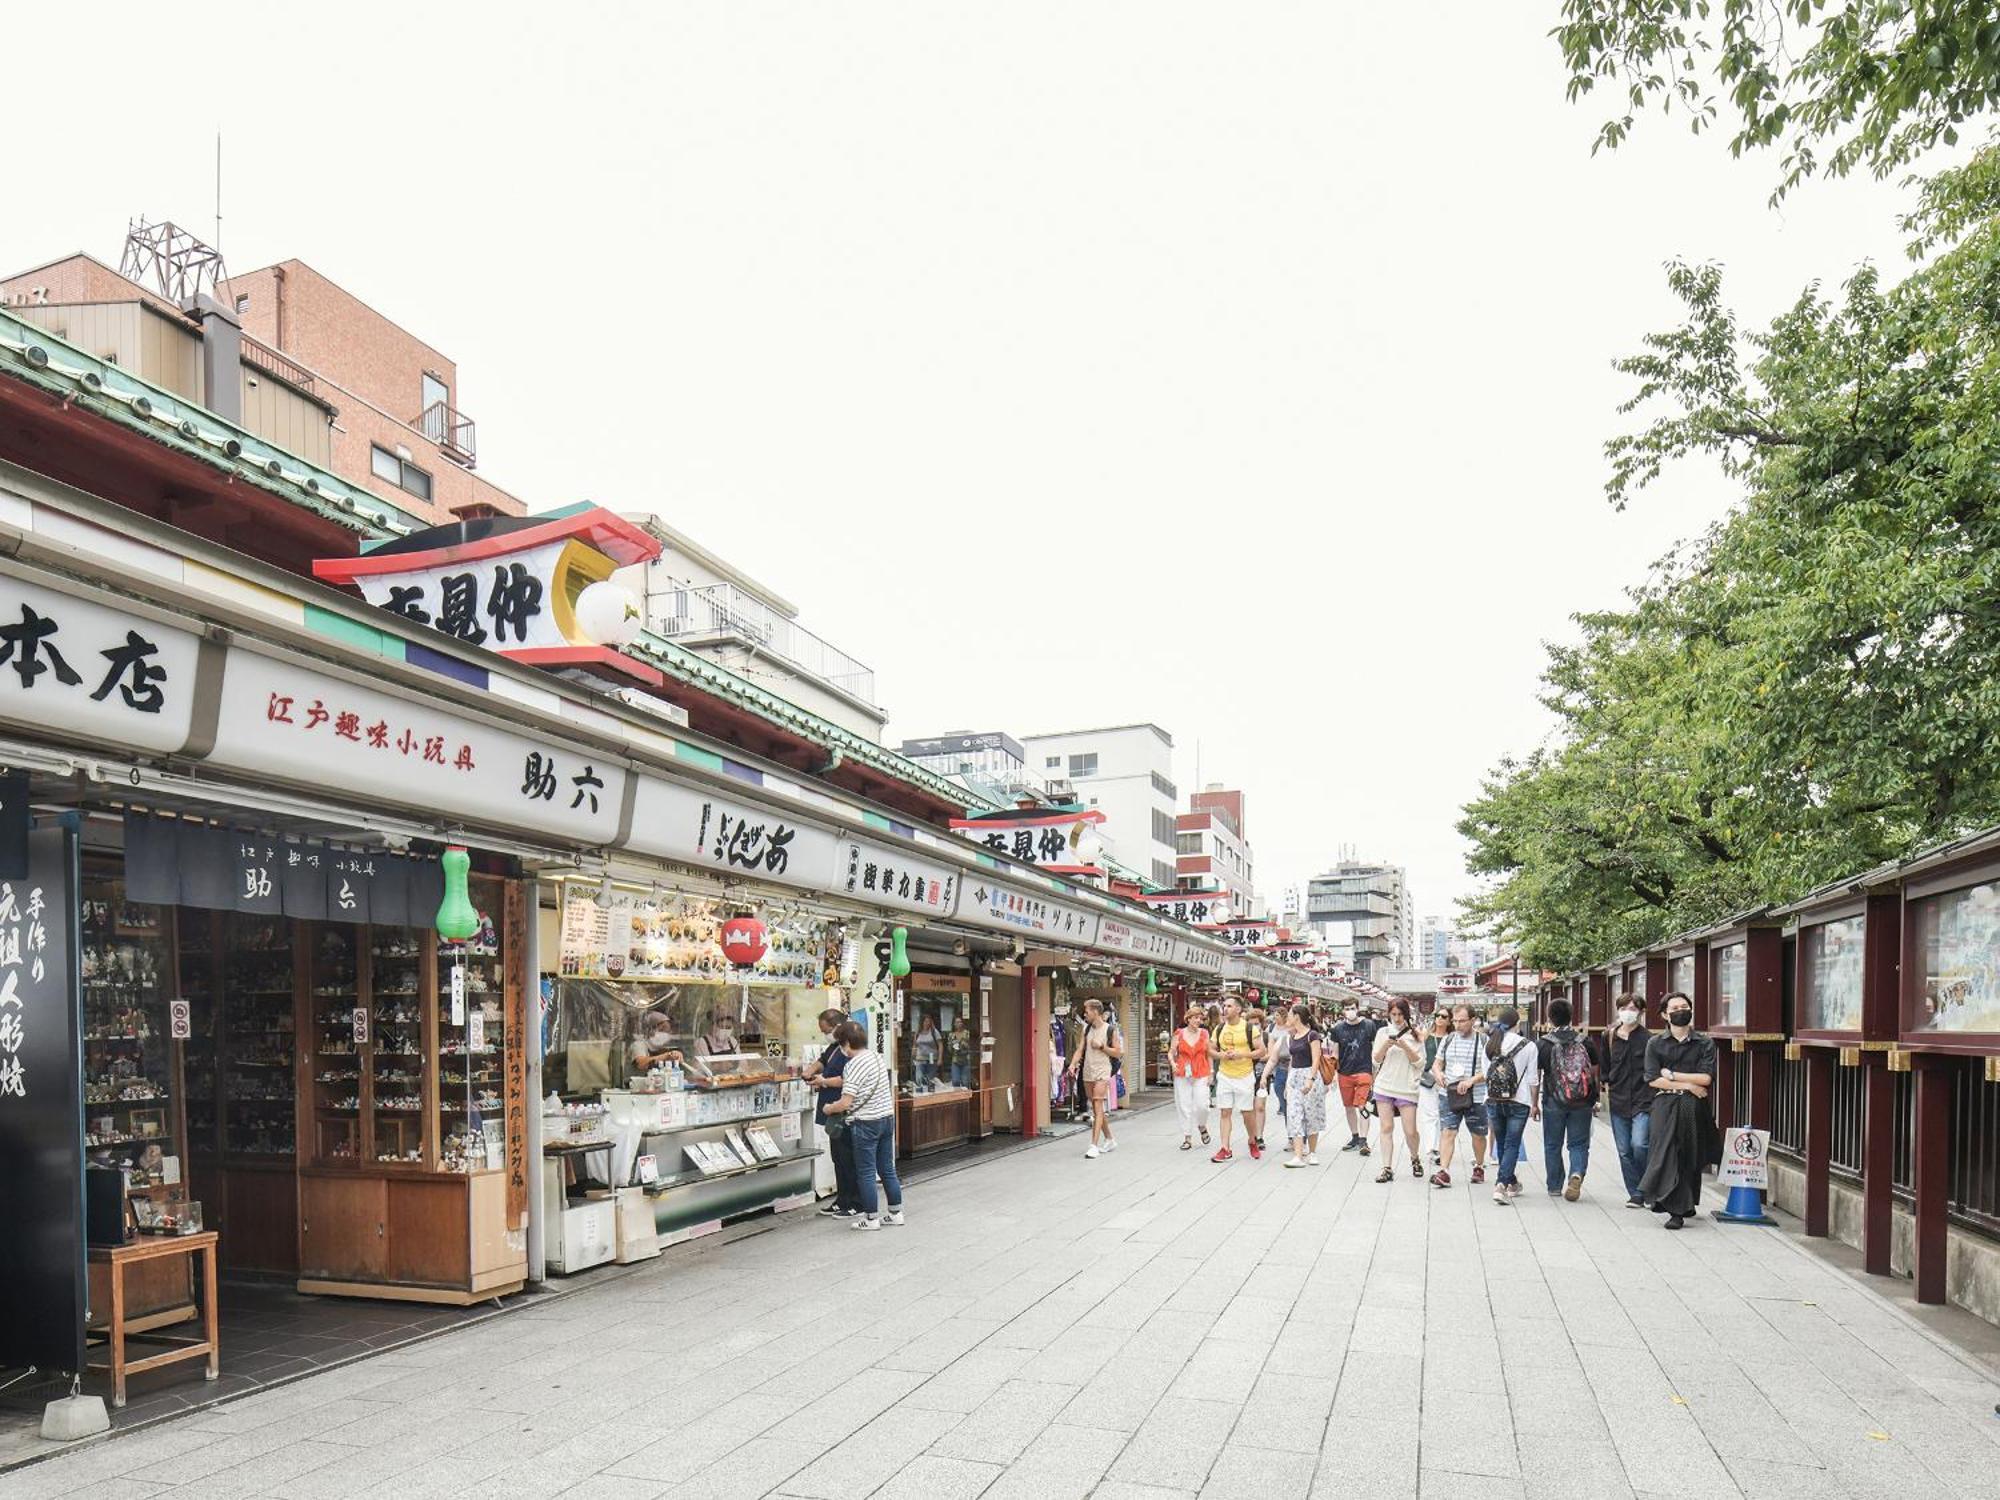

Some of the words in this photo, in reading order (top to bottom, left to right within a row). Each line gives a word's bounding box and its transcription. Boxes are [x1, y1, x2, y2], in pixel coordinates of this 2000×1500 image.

[0, 603, 168, 714] 本店
[267, 692, 476, 772] 江戸趣味小玩具
[521, 751, 605, 815] 助六
